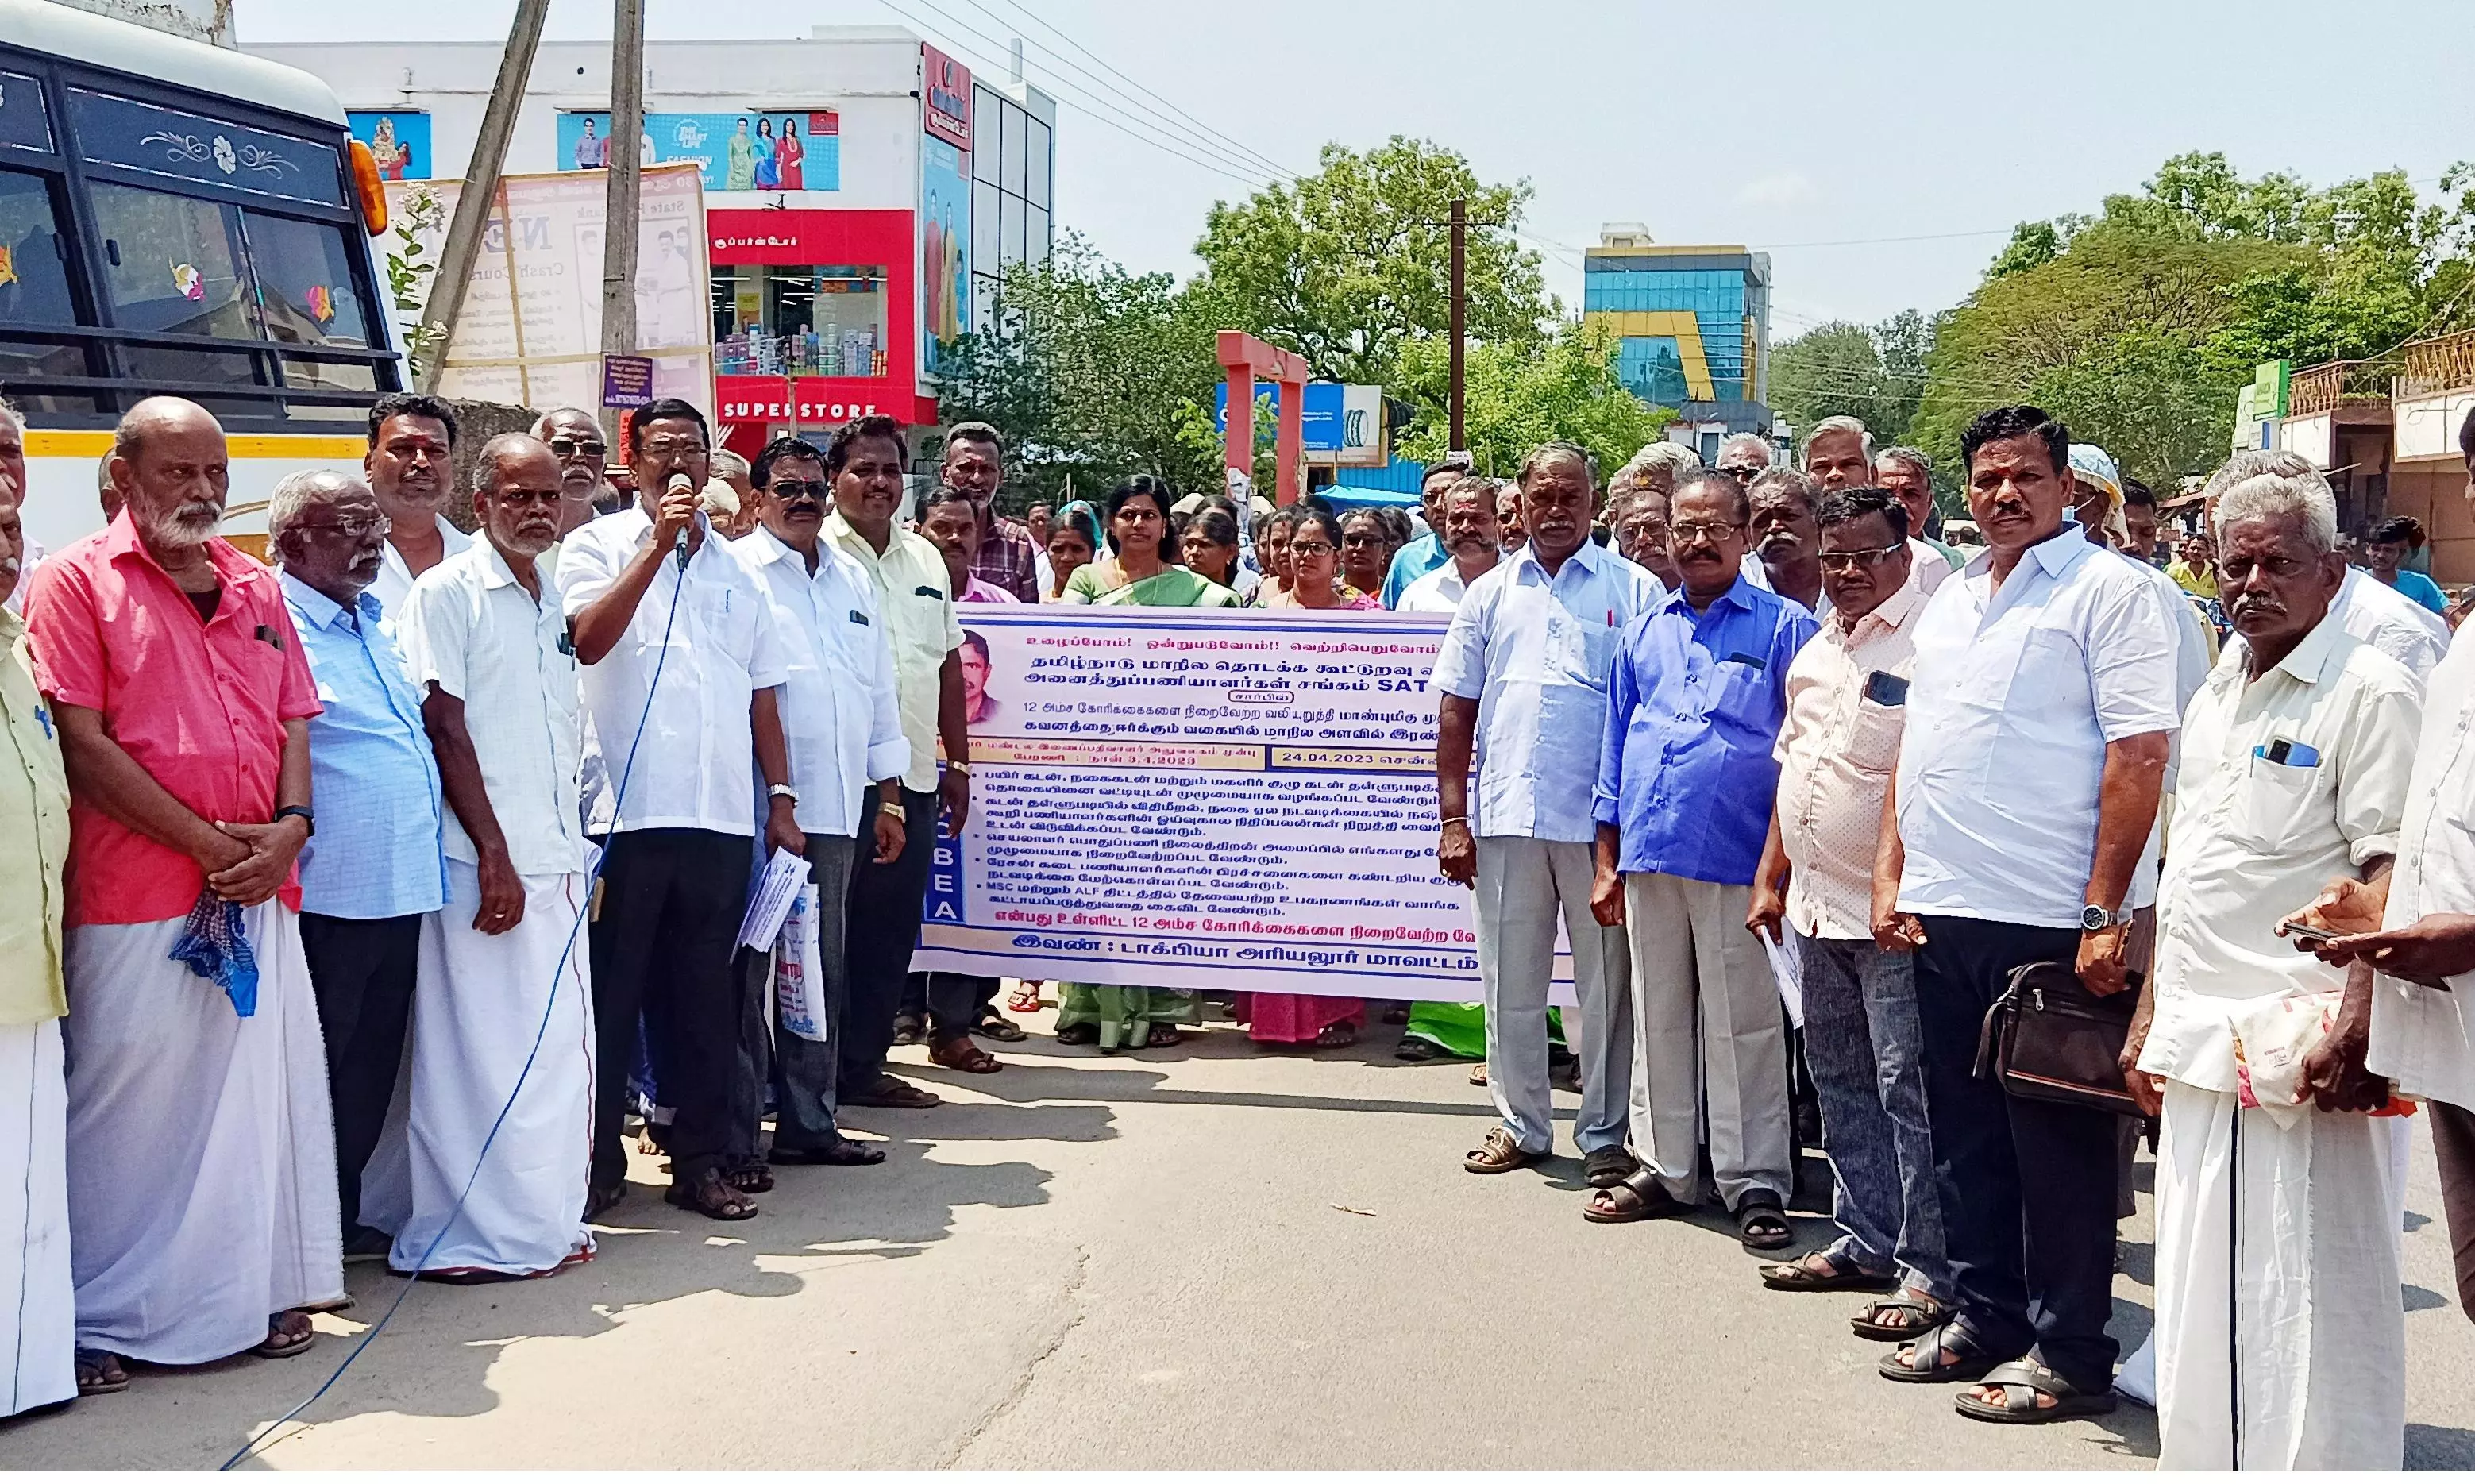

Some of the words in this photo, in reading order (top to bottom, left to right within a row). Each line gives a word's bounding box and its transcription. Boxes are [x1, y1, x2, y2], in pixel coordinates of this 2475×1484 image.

[1027, 637, 1131, 647] உழைப்போம்!
[1147, 638, 1278, 650] ஒன்றுபடுவோம்!!
[1031, 656, 1134, 669] தமிழ்நாடு
[1143, 658, 1208, 672] மாநில
[1216, 661, 1308, 673] தொடக்க
[1316, 664, 1412, 676] கூட்டுறவு
[1024, 673, 1290, 688] அனைத்துப்பணியாளர்கள்
[1298, 678, 1369, 690] சங்கம்
[1234, 694, 1290, 703] சார்பில்
[1024, 702, 1037, 711] 12
[1043, 703, 1073, 712] அம்ச
[1078, 702, 1180, 715] கோரிக்கைகளை
[1185, 705, 1260, 721] நிறைவேற்ற
[1266, 707, 1334, 723] வலியுறுத்தி
[1340, 708, 1417, 723] மாண்புமிகு
[1184, 726, 1259, 735] வகையில்
[1265, 727, 1313, 740] மாநில
[1319, 729, 1384, 738] அளவில்
[1283, 753, 1373, 763] 24.04.2023
[1155, 776, 1207, 787] மற்றும்
[1268, 781, 1301, 790] குழு
[985, 784, 1094, 794] தொகையினை
[1099, 788, 1172, 797] வட்டியுடன்
[1177, 792, 1274, 800] முழுமையாக
[1278, 793, 1362, 803] வழங்கப்பட
[1027, 799, 1128, 810] தள்ளுபடியில்
[1282, 808, 1403, 818] நடவடிக்கையில்
[986, 809, 1020, 819] கூறி
[1024, 811, 1151, 822] பணியாளர்களின்
[1157, 815, 1232, 825] ஓய்வுகால
[1236, 817, 1339, 827] நிதிப்பலன்கள்
[1344, 821, 1397, 831] நிறுத்தி
[1029, 823, 1126, 833] விடுவிக்கப்பட
[1131, 826, 1205, 837] வேண்டும்.
[987, 834, 1064, 843] செயலாளர்
[1070, 838, 1158, 848] பொதுப்பணி
[1162, 840, 1257, 851] நிலைத்திறன்
[1263, 844, 1344, 854] அமைப்பில்
[1349, 846, 1420, 858] எங்களது
[987, 846, 1082, 858] முழுமையாக
[1087, 850, 1204, 861] நிறைவேற்றப்பட
[1209, 854, 1287, 865] வேண்டும்.
[987, 858, 1034, 867] ரேசன்
[1081, 863, 1212, 874] பணியாளர்களின்
[1217, 868, 1342, 879] பிரச்சனைகளை
[1348, 873, 1425, 883] கண்டறிய
[988, 871, 1074, 881] நடவடிக்கை
[1078, 874, 1205, 886] மேற்கொள்ளப்பட
[1211, 880, 1288, 890] வேண்டும்.
[986, 882, 1013, 891] MSC
[1018, 885, 1070, 895] மற்றும்
[1104, 888, 1176, 899] திட்டத்தில்
[1181, 892, 1274, 904] தேவையற்ற
[1280, 896, 1400, 908] உபகரணங்கள்
[1405, 900, 1459, 910] வாங்க
[989, 896, 1143, 911] கட்டாயப்படுத்துவதை
[1147, 904, 1202, 912] கைவிட
[1208, 905, 1285, 916] வேண்டும்.
[995, 910, 1052, 927] என்பது
[1057, 913, 1127, 927] உள்ளிட்ட
[1133, 917, 1148, 927] 12
[1153, 918, 1195, 930] அம்ச
[1202, 919, 1344, 936] கோரிக்கைகளை
[1351, 926, 1448, 944] நிறைவேற்ற
[1012, 935, 1101, 952] இவண்
[1121, 942, 1229, 958] டாக்பியா
[1236, 947, 1359, 966] அரியலூர்
[1367, 954, 1478, 969] மாவட்டம்
